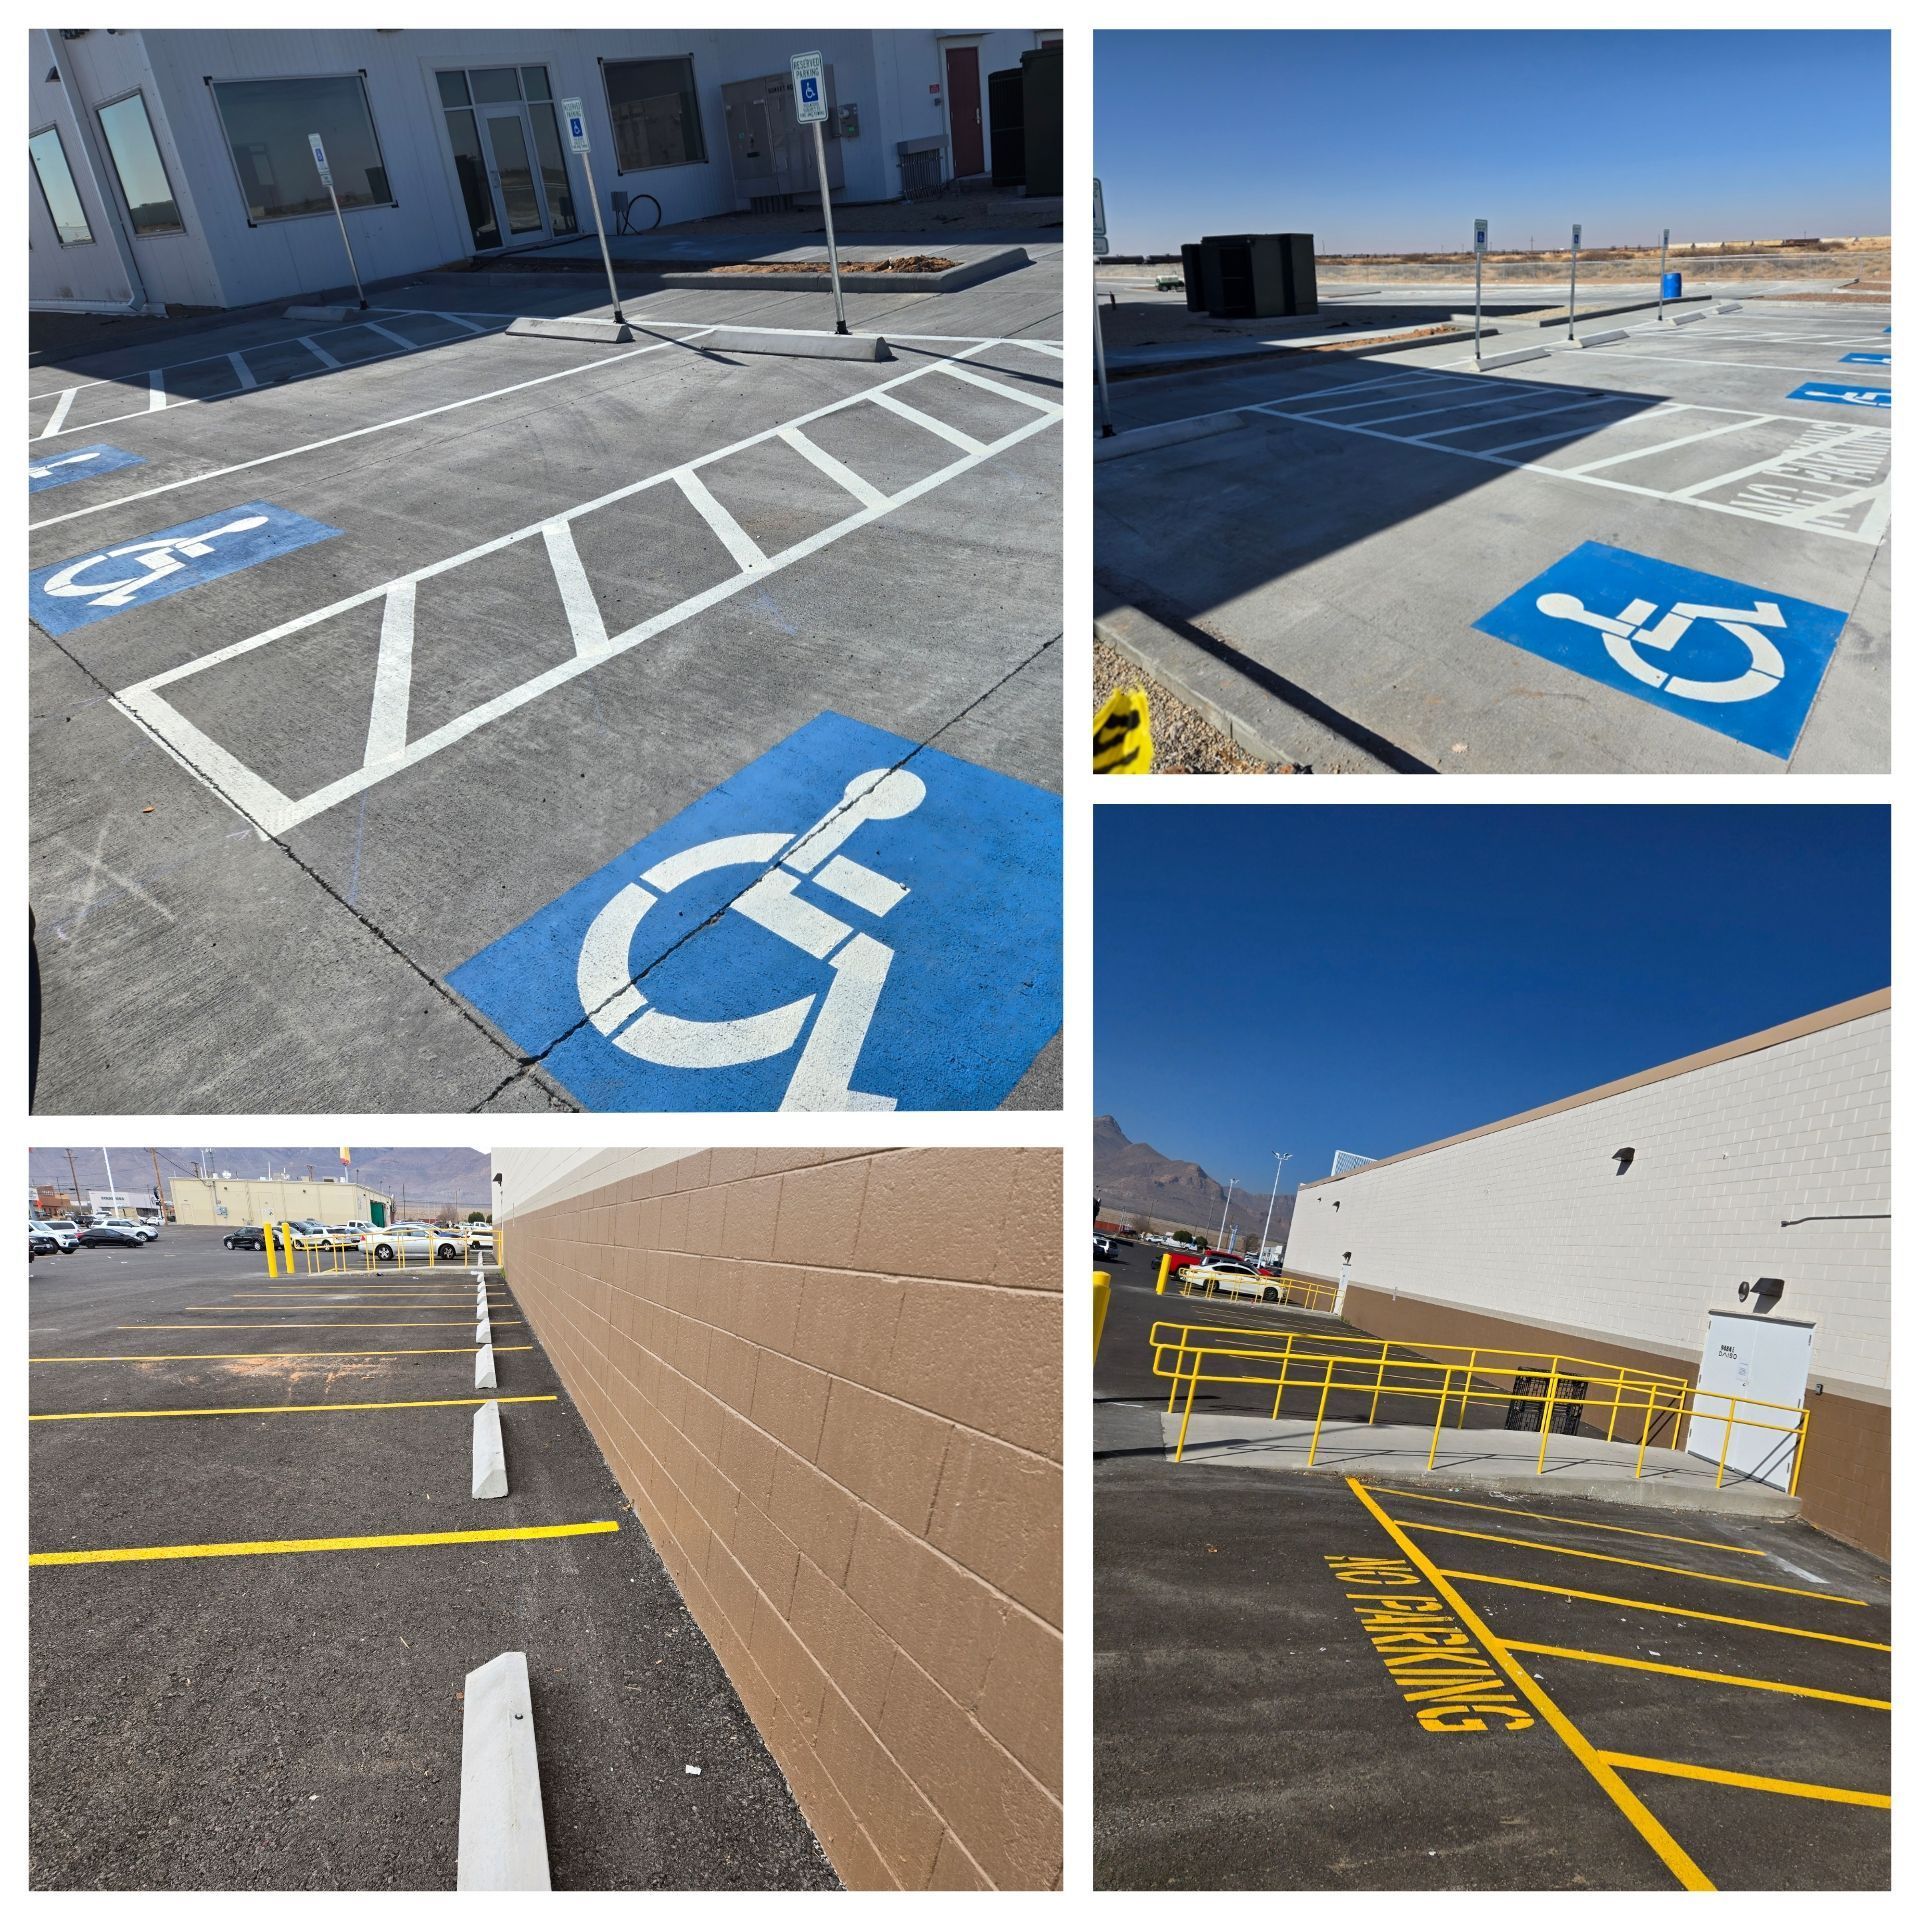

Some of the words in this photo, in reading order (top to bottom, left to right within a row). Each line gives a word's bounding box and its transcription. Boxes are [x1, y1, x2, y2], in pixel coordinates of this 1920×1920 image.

[794, 57, 819, 69] RESERVED
[796, 68, 819, 79] PARKING
[1718, 1350, 1737, 1359] DAISO
[1324, 1556, 1421, 1585] NO
[1346, 1593, 1535, 1732] PARKING
